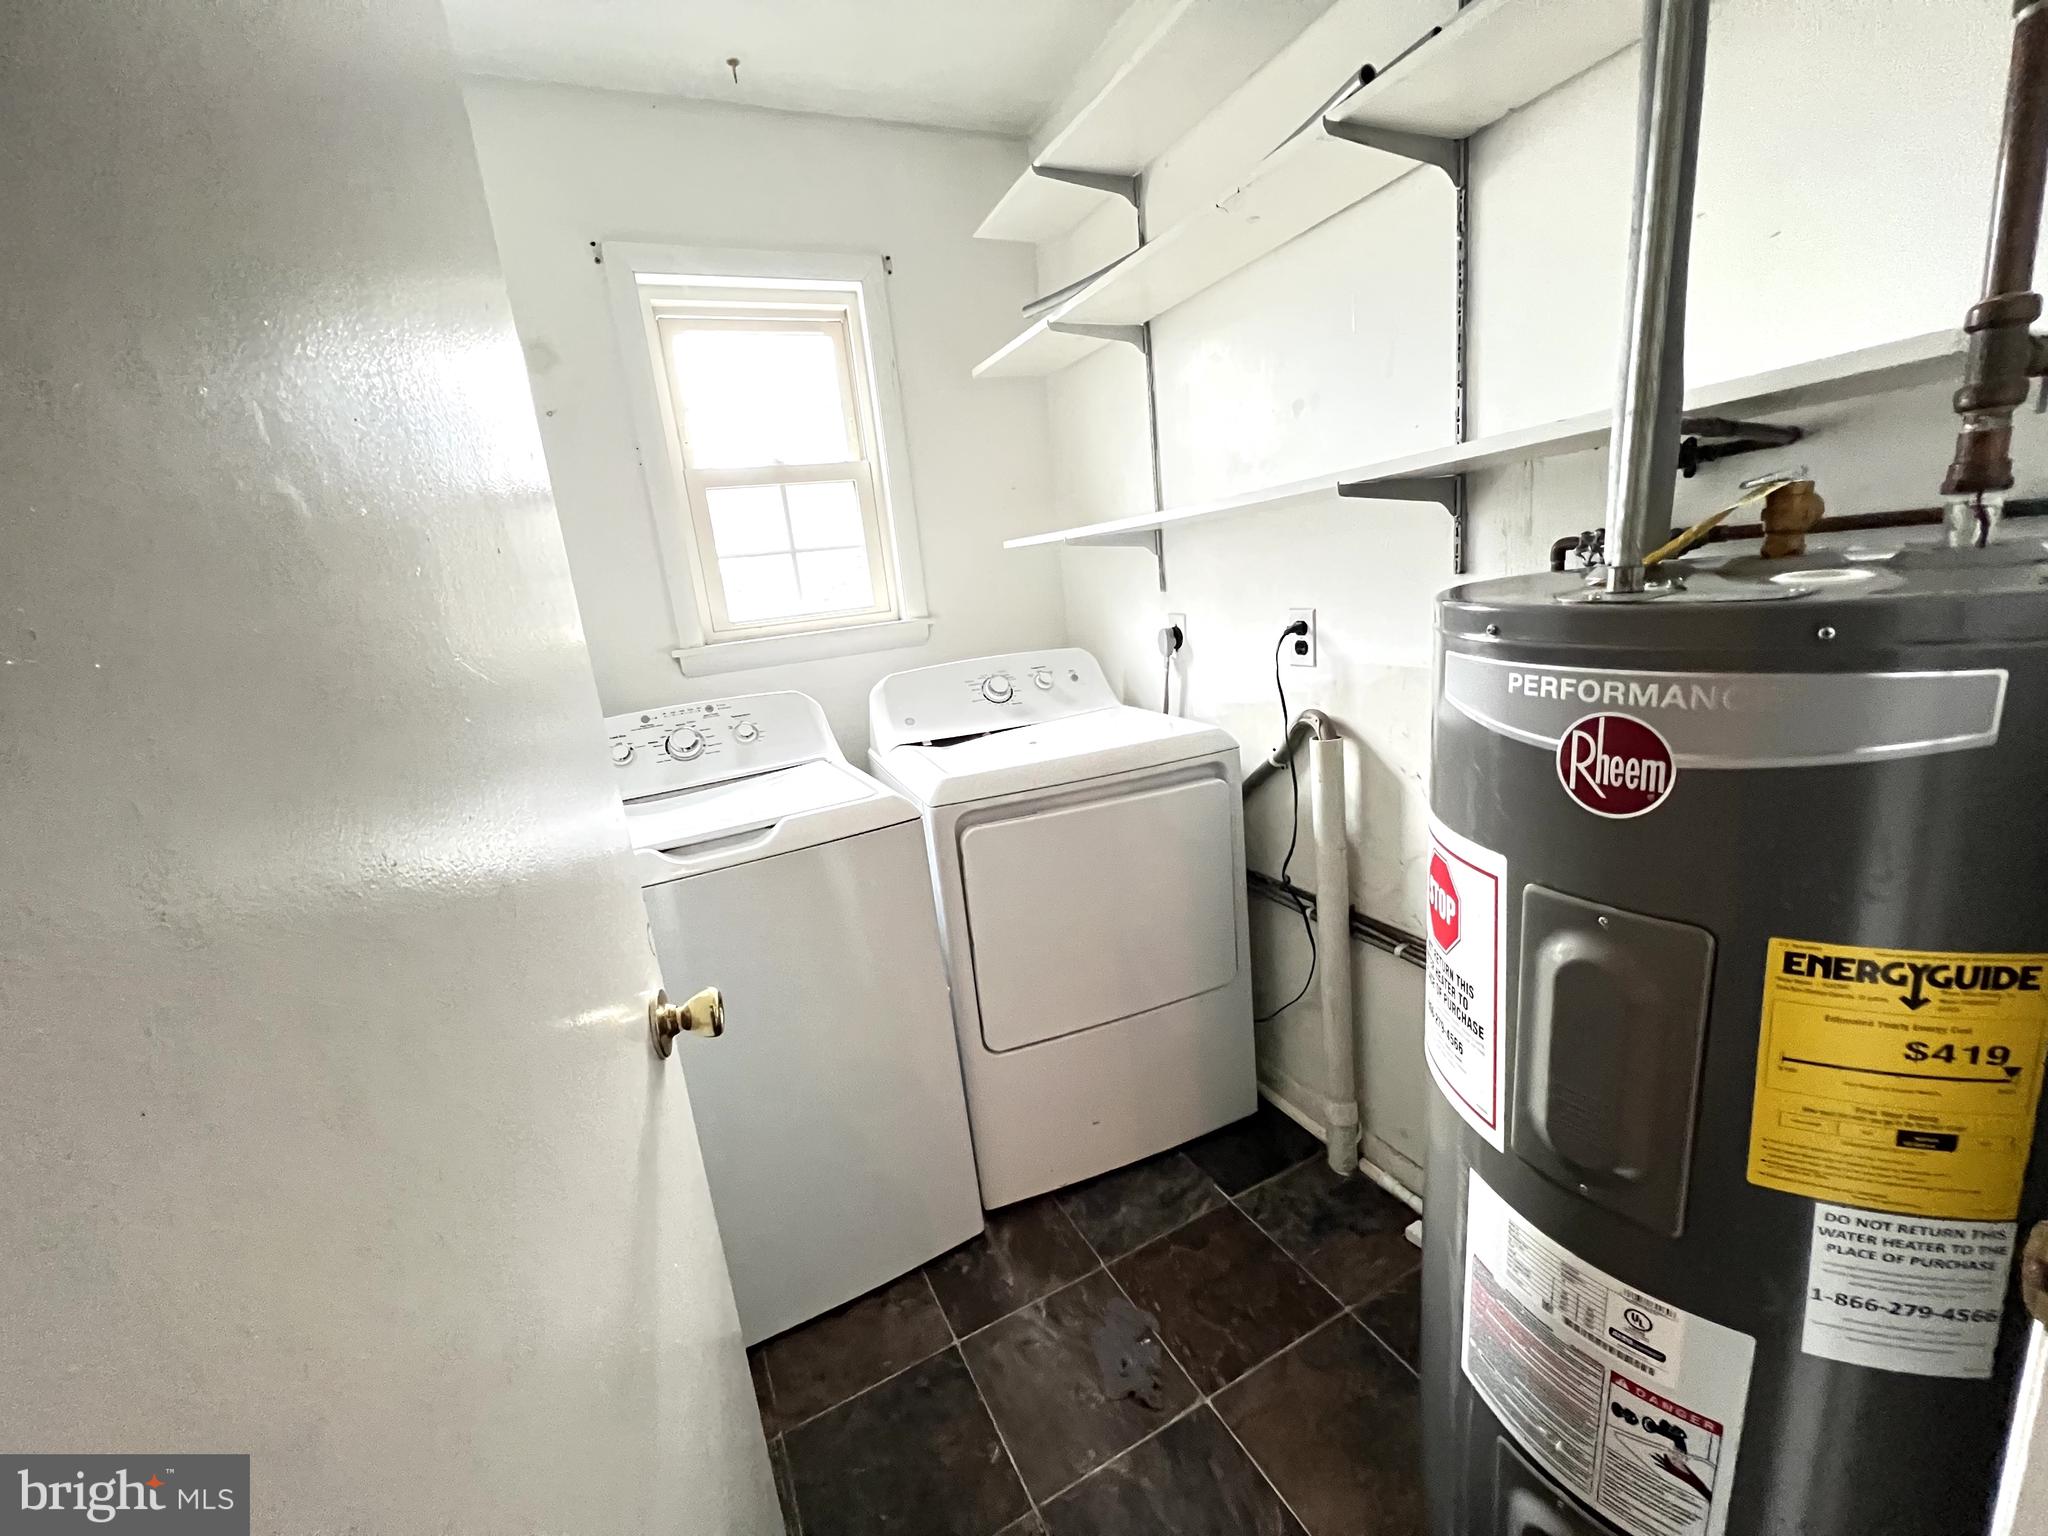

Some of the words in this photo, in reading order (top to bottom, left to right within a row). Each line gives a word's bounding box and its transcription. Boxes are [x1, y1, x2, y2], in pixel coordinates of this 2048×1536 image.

[1569, 717, 1667, 799] Rheem
[1430, 874, 1456, 926] STOP
[1783, 950, 2043, 991] ENERGYGUIDE
[1456, 973, 1474, 999] THIS
[1443, 992, 1485, 1040] PURCHASE
[1458, 992, 1469, 1011] TO
[1903, 1041, 2011, 1066] $419
[1817, 1225, 1878, 1245] WATER
[1882, 1236, 1947, 1254] HEATER
[1824, 1212, 1851, 1225] DO
[1856, 1217, 1892, 1232] NOT
[1897, 1223, 1965, 1240] RETURN
[1825, 1242, 1878, 1260] PLACE
[1882, 1252, 1906, 1264] OF
[1634, 1387, 1715, 1432] DANGER
